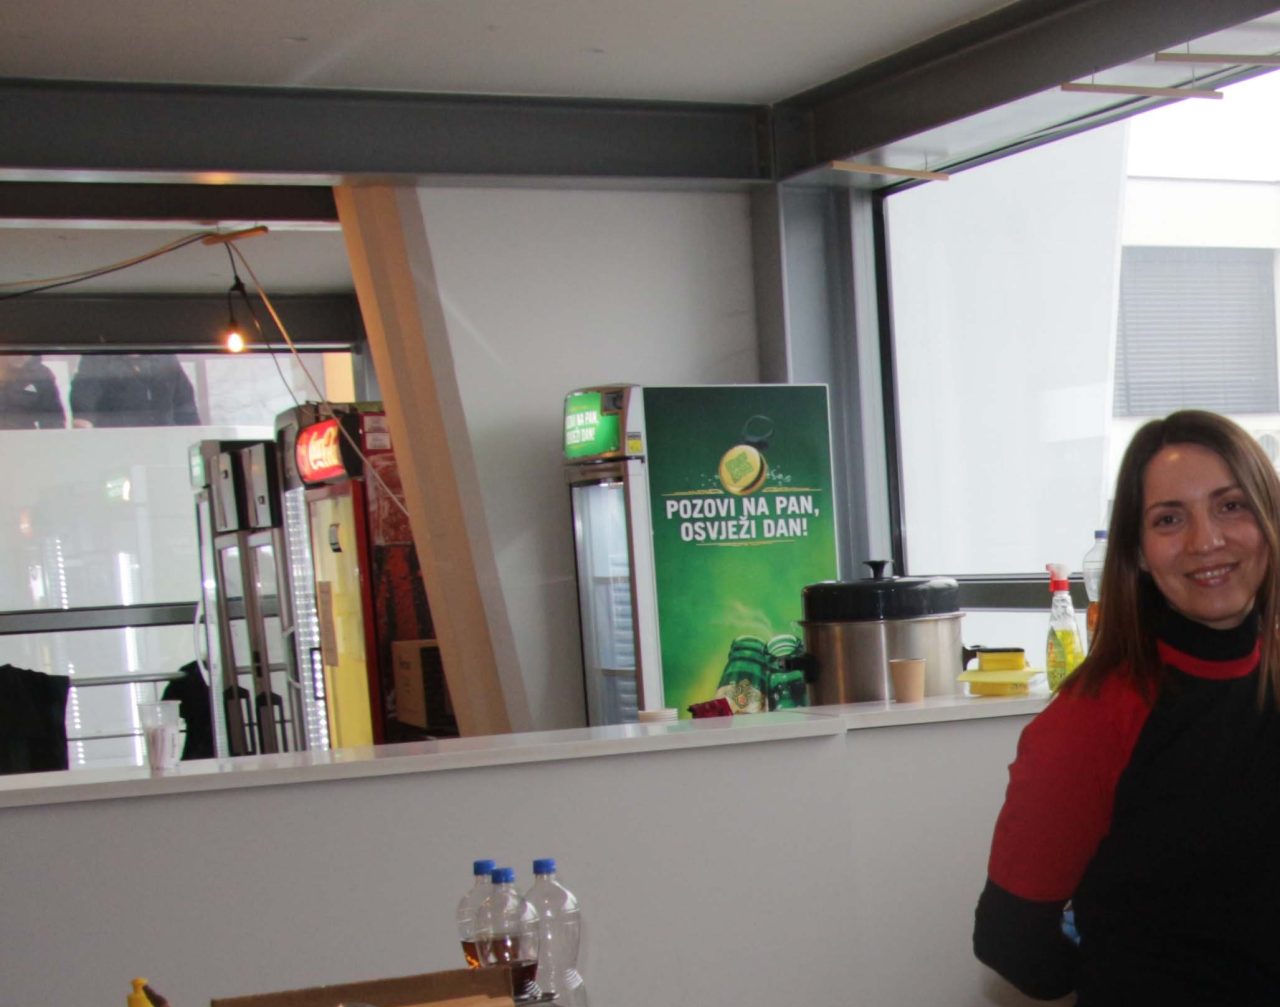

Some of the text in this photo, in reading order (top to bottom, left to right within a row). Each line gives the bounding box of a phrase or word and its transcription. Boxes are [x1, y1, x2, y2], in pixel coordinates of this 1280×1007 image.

[665, 495, 820, 520] POZOVI NA PAN,
[680, 517, 808, 542] OSVJEŽI DAN!
